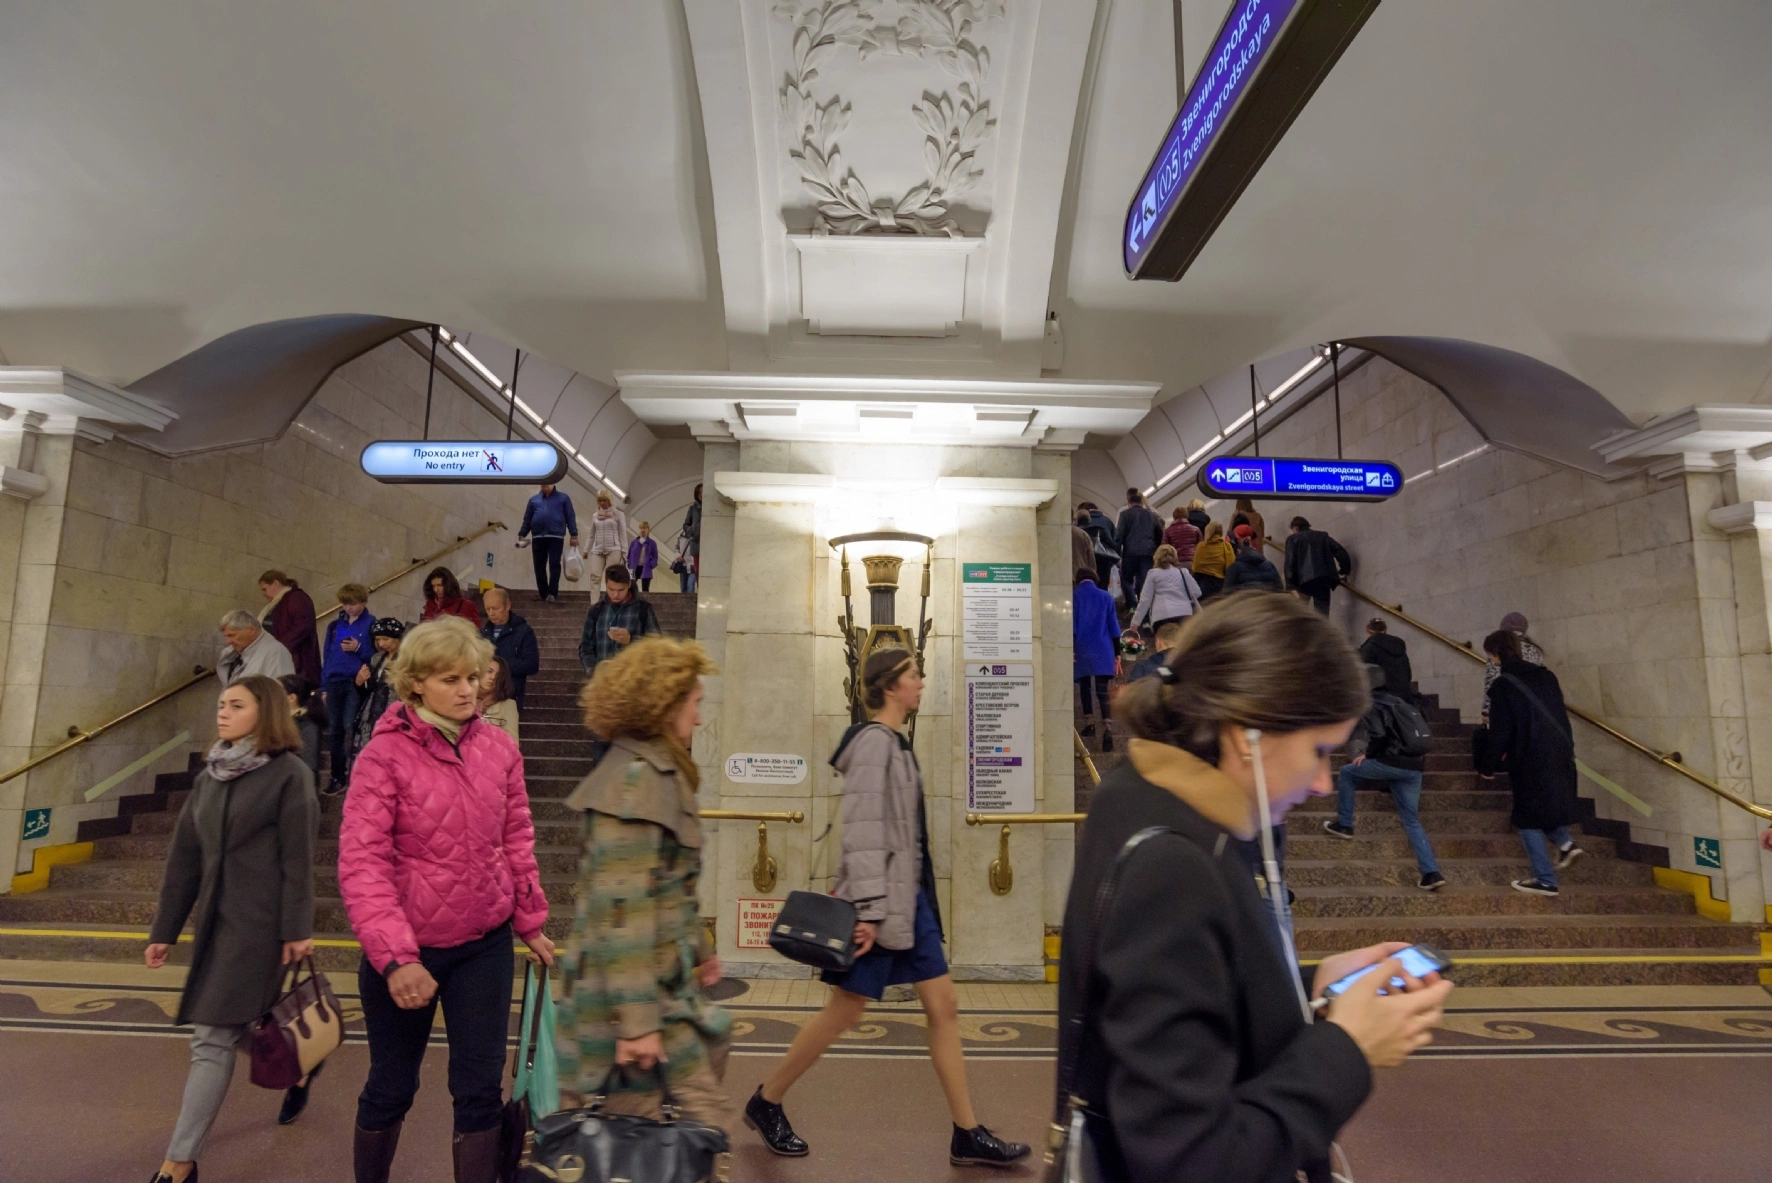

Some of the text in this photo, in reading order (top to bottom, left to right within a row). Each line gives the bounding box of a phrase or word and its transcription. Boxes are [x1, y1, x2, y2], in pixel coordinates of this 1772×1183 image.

[1182, 12, 1271, 171] Zvenigorodskaya
[413, 448, 480, 460] Прохода нет
[425, 461, 466, 472] No entry
[1302, 464, 1364, 475] Звенигородская
[1340, 474, 1364, 483] улица
[1287, 482, 1365, 493] Zvenigorodskaya street
